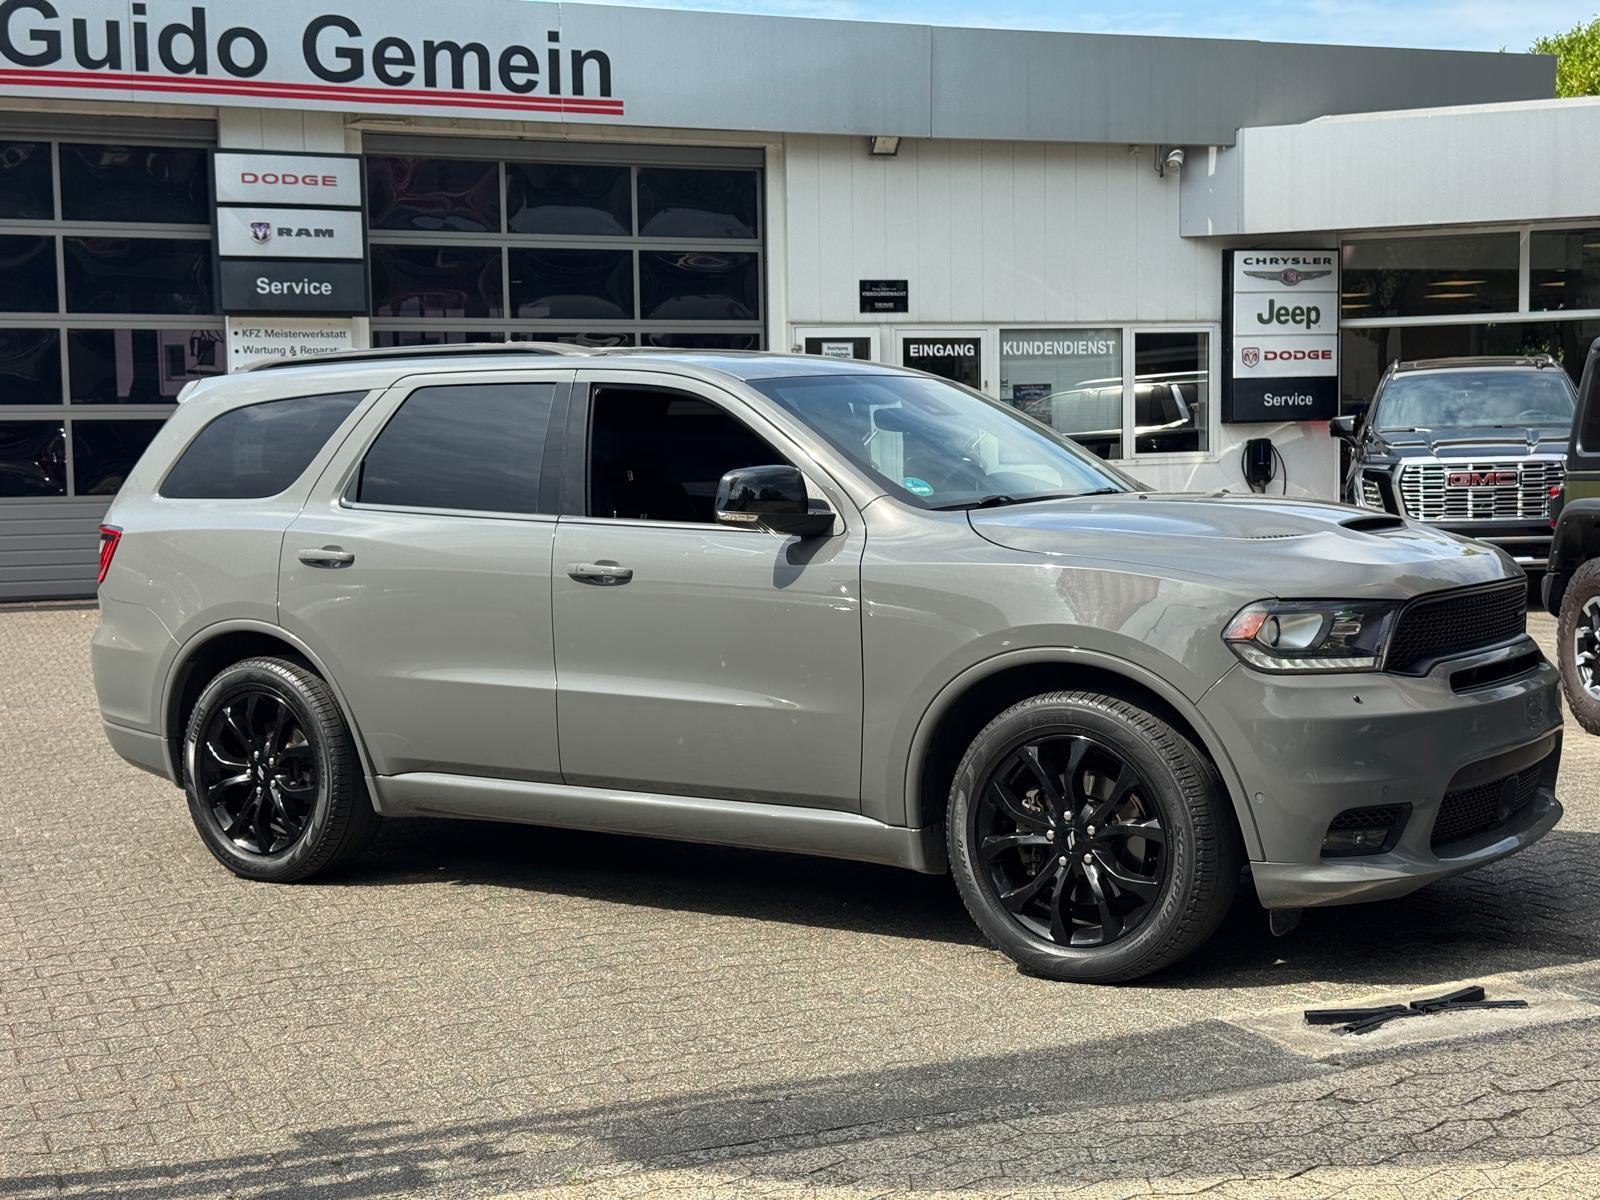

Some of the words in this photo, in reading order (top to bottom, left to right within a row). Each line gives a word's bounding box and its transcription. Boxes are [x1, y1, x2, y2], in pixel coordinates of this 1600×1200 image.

[0, 0, 268, 78] Guido
[302, 14, 612, 97] Gemein
[241, 172, 337, 186] DODGE
[277, 227, 335, 238] RAM
[1243, 257, 1332, 265] CHRYSLER
[256, 277, 333, 295] Service
[1257, 299, 1321, 329] Jeep
[242, 329, 262, 338] KFZ
[264, 329, 347, 339] Meisterwerkstatt
[242, 345, 286, 357] Wartung
[289, 346, 297, 356] &
[300, 346, 338, 355] Reparat
[909, 344, 975, 357] EINGANG
[1002, 341, 1116, 356] KUNDENDIENST
[1263, 350, 1332, 360] DODGE
[1263, 392, 1313, 406] Service
[1450, 473, 1517, 486] GMC
